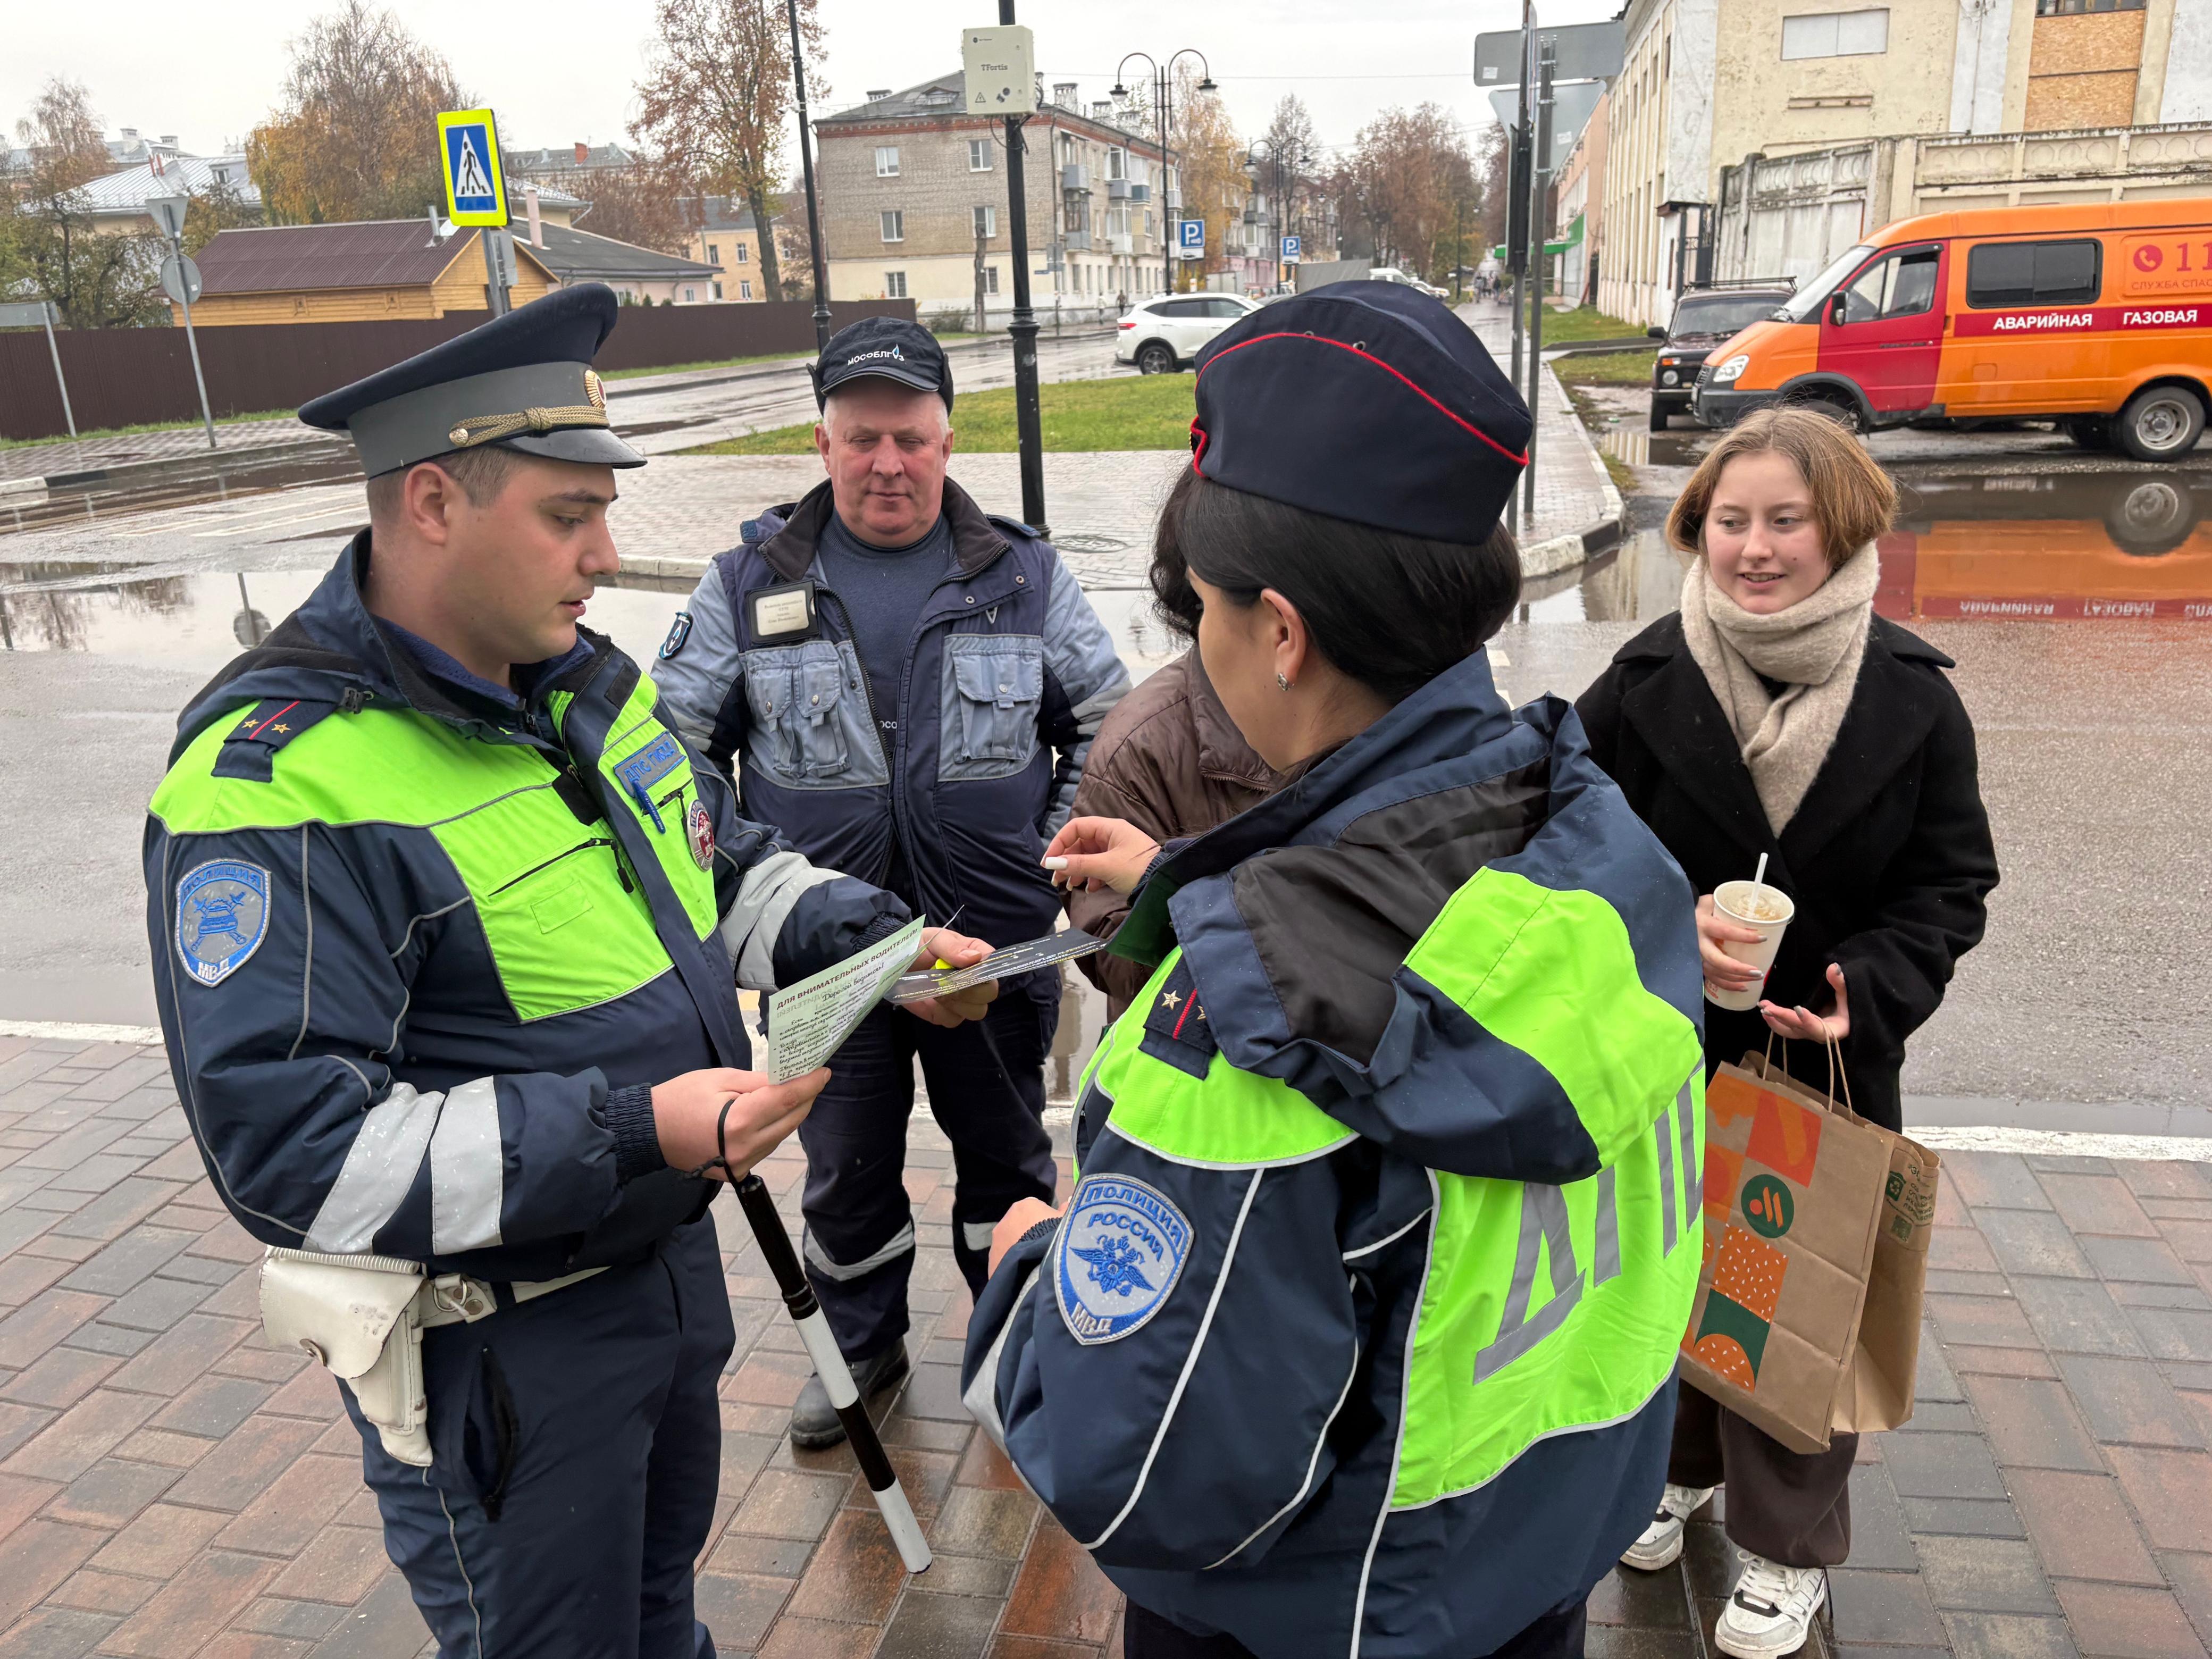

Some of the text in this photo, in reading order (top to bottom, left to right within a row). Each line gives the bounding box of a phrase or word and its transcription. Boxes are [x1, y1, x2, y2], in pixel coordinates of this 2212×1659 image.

[1185, 224, 1199, 245] P
[1286, 240, 1297, 253] P
[2132, 280, 2179, 290] СЛУЖБА
[1993, 309, 2198, 330] АВАРИЙНАЯ ГАЗОВАЯ
[197, 958, 230, 981] МВД
[777, 995, 795, 1010] ДЛЯ
[797, 959, 869, 999] ВНИМАТЕЛЬНЫХ
[1086, 1186, 1184, 1247] ПОЛИЦИЯ
[1088, 1212, 1164, 1262] РОССИЯ
[1071, 1301, 1113, 1335] МВД
